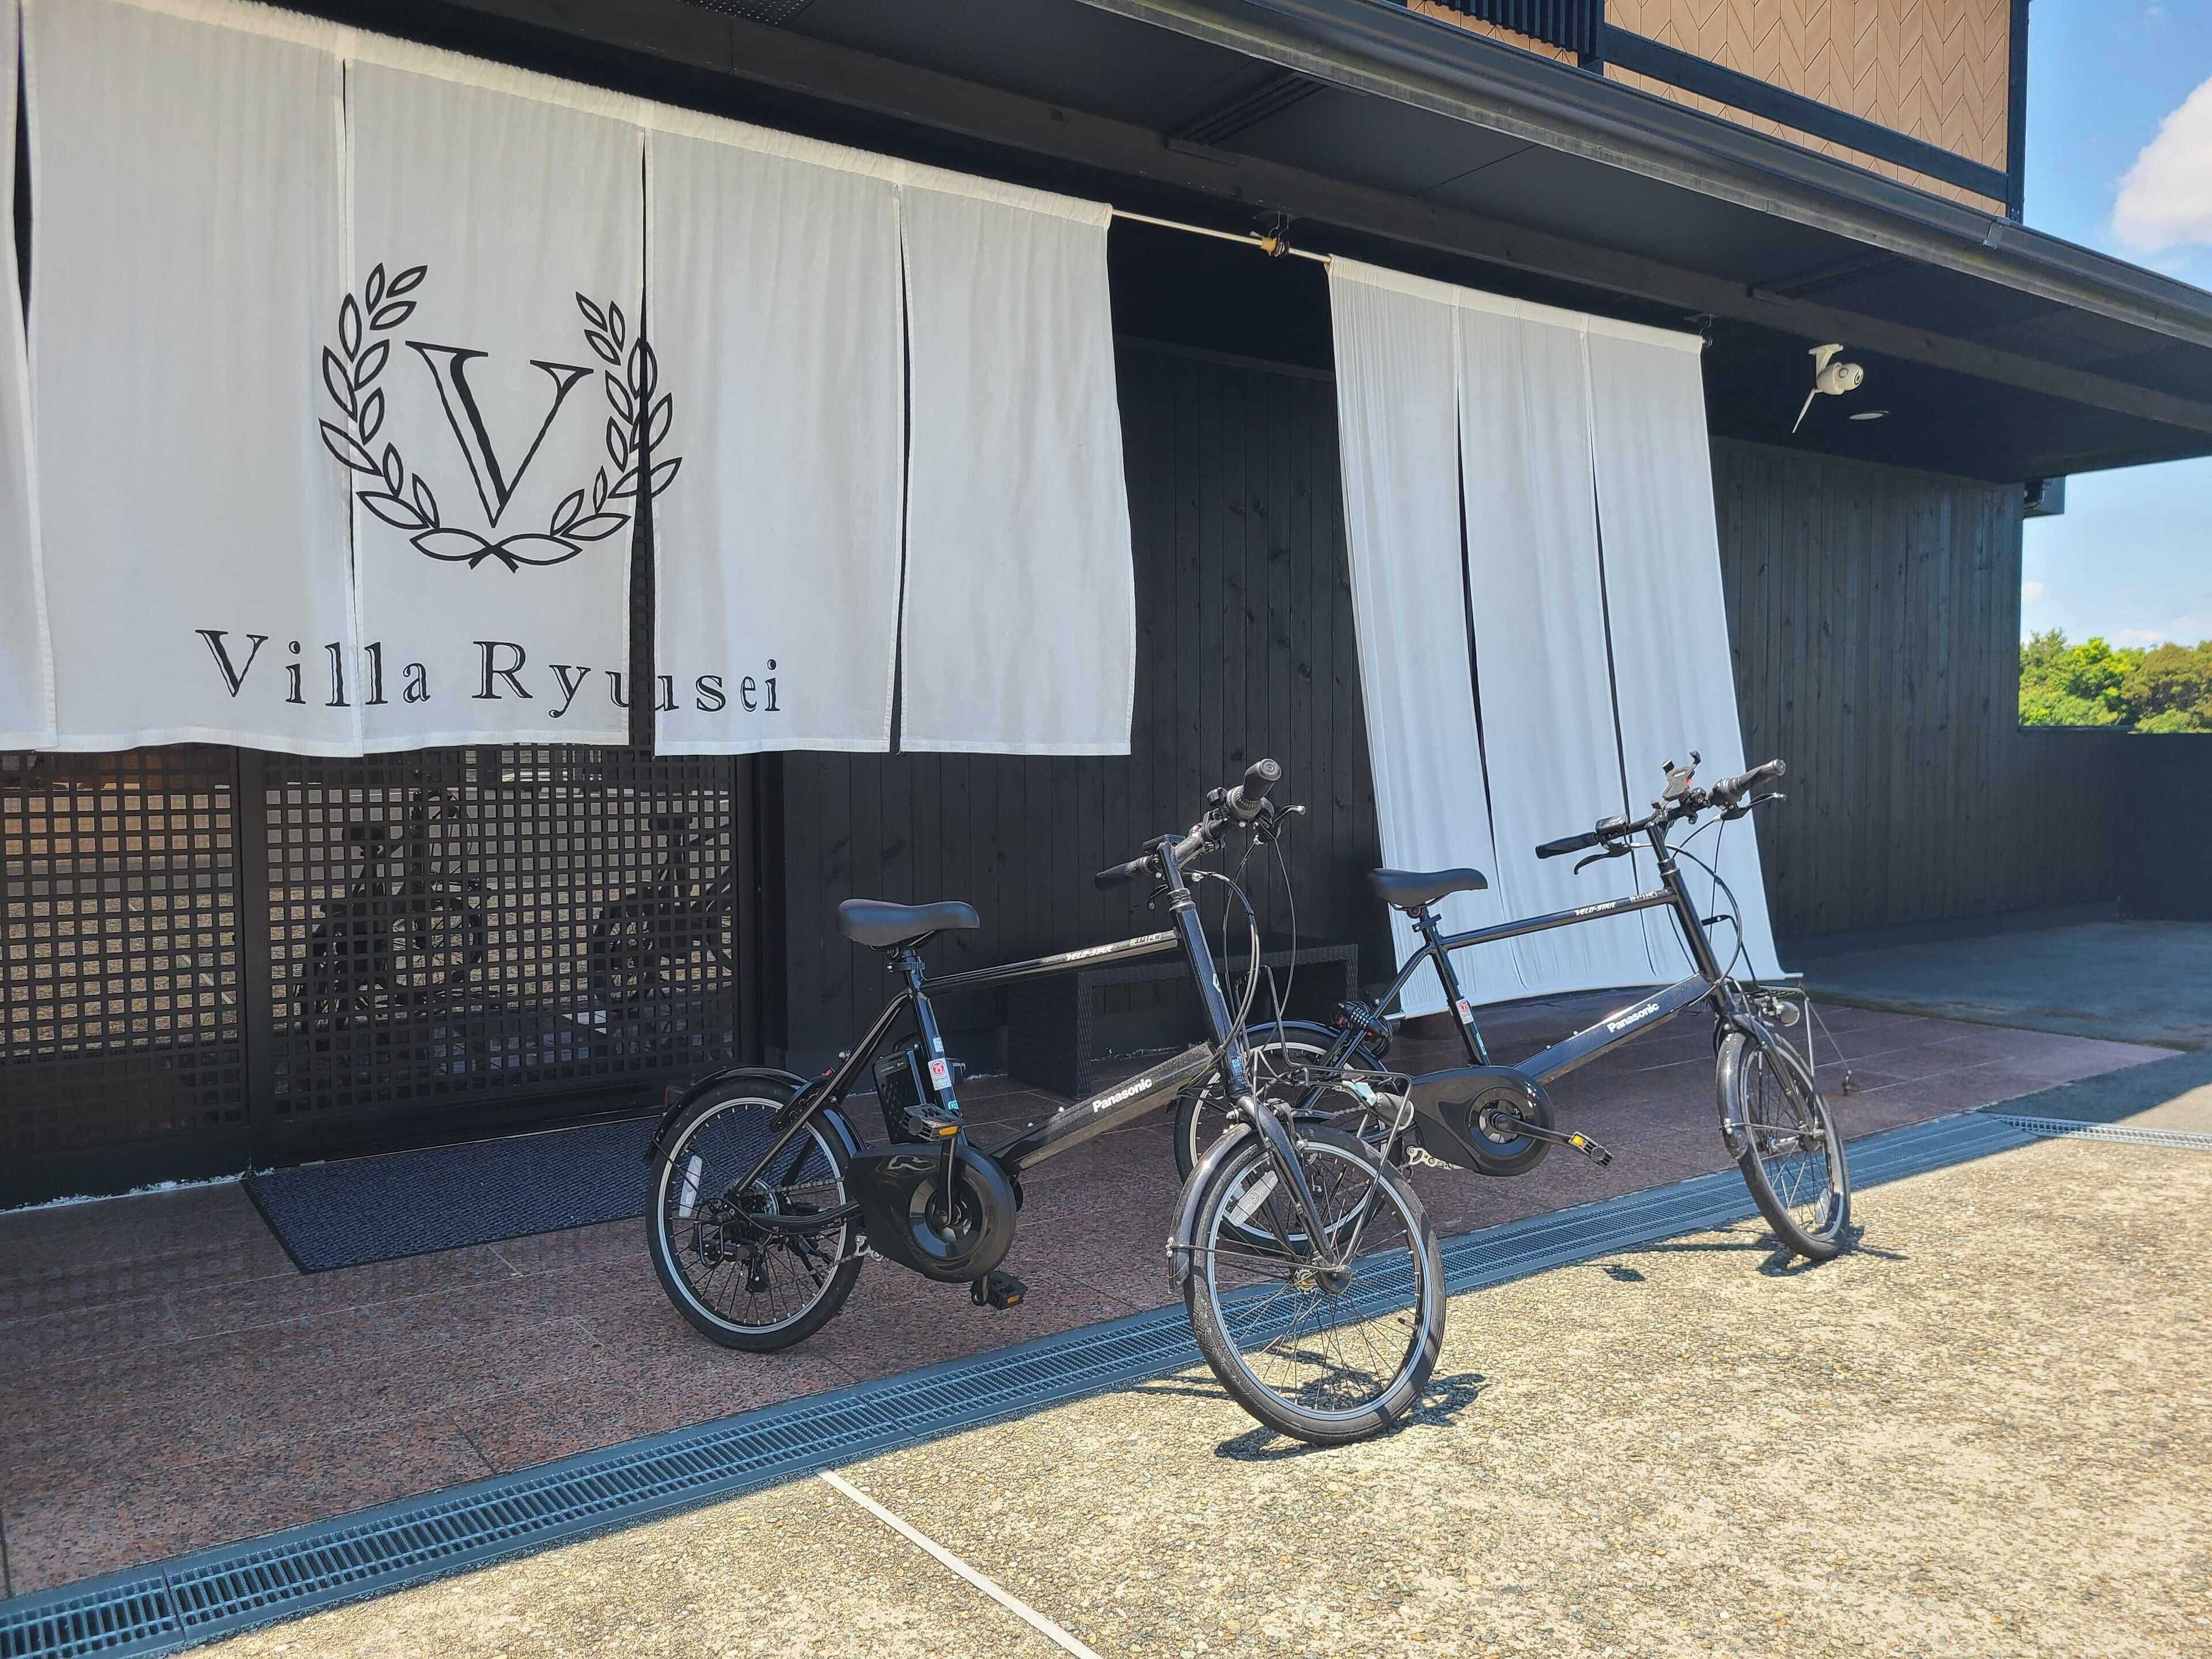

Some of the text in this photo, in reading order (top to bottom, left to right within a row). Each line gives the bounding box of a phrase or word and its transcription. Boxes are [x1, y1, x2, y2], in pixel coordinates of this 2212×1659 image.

[405, 340, 594, 529] V
[195, 629, 431, 707] Villa
[1607, 1003, 1660, 1033] Panasonic
[1092, 1078, 1153, 1113] Panasonic
